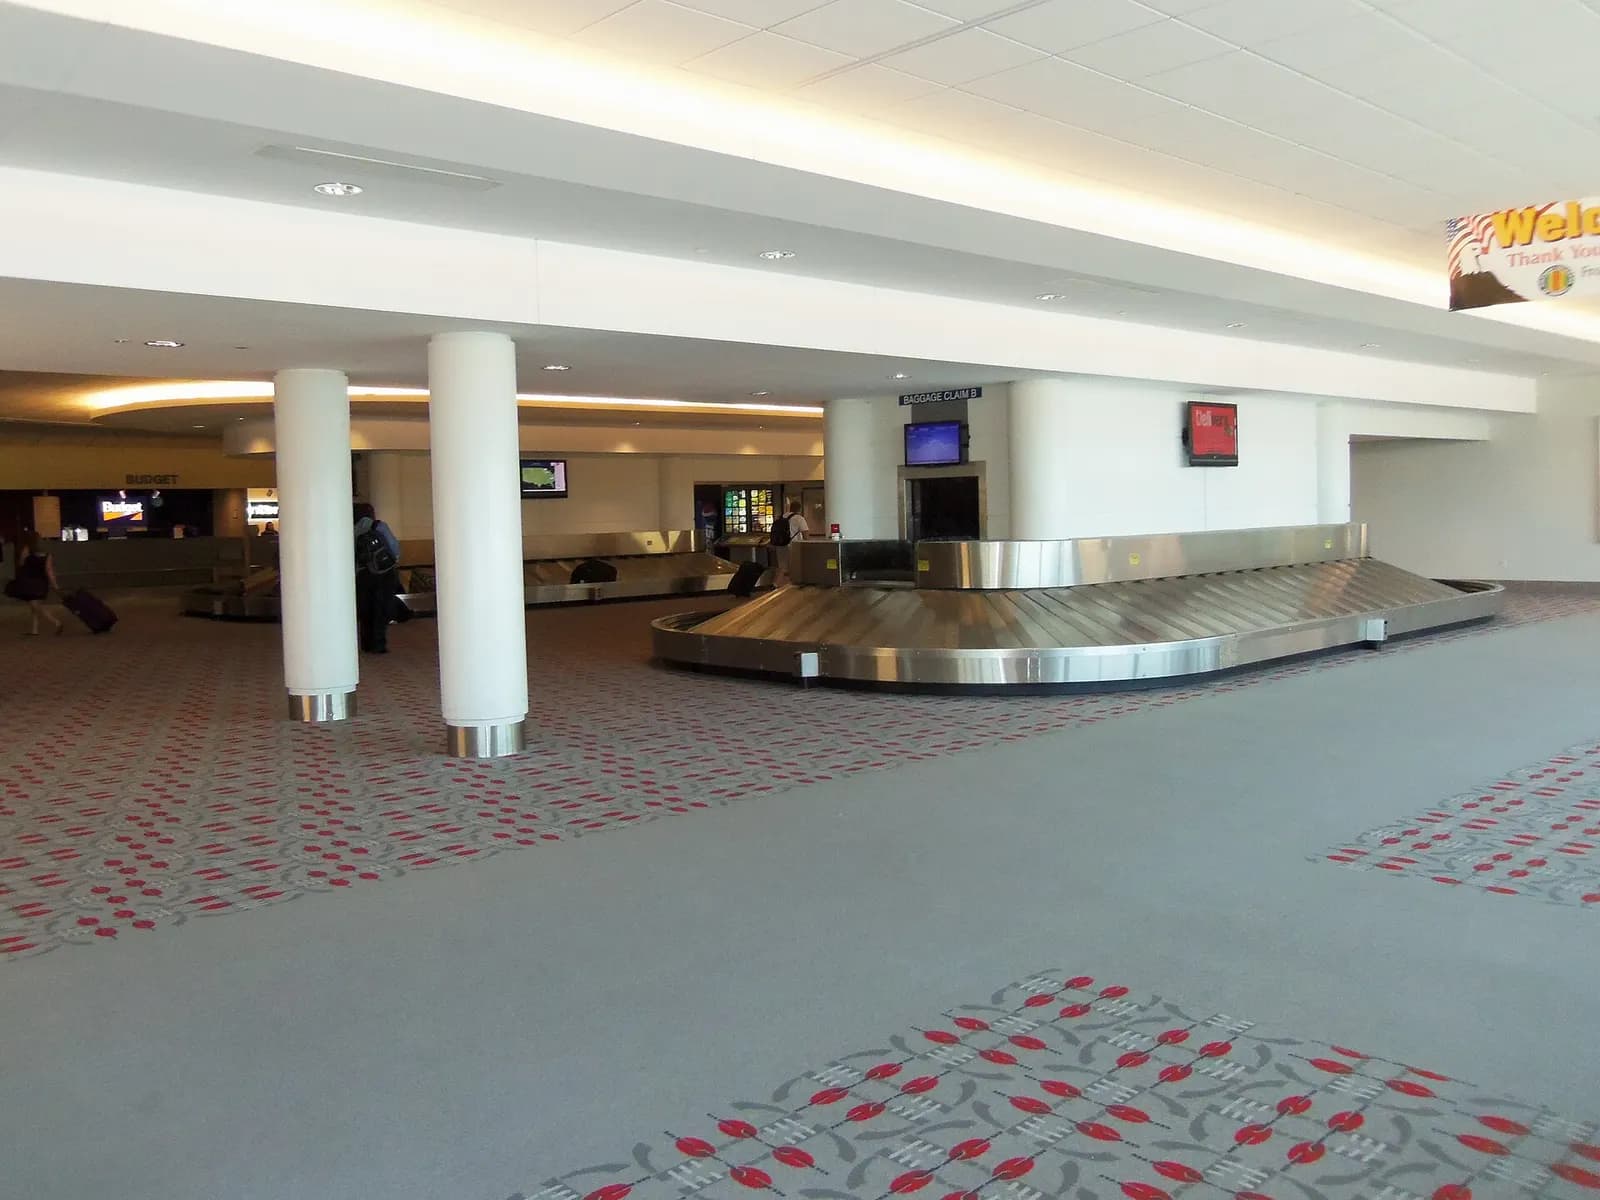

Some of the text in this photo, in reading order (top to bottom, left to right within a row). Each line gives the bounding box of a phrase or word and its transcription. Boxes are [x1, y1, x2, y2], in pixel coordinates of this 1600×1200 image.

[1506, 247, 1563, 267] Thank
[903, 388, 977, 404] BAGGAGE CLAIM B
[126, 474, 178, 485] BUDGET
[102, 501, 144, 513] Budget
